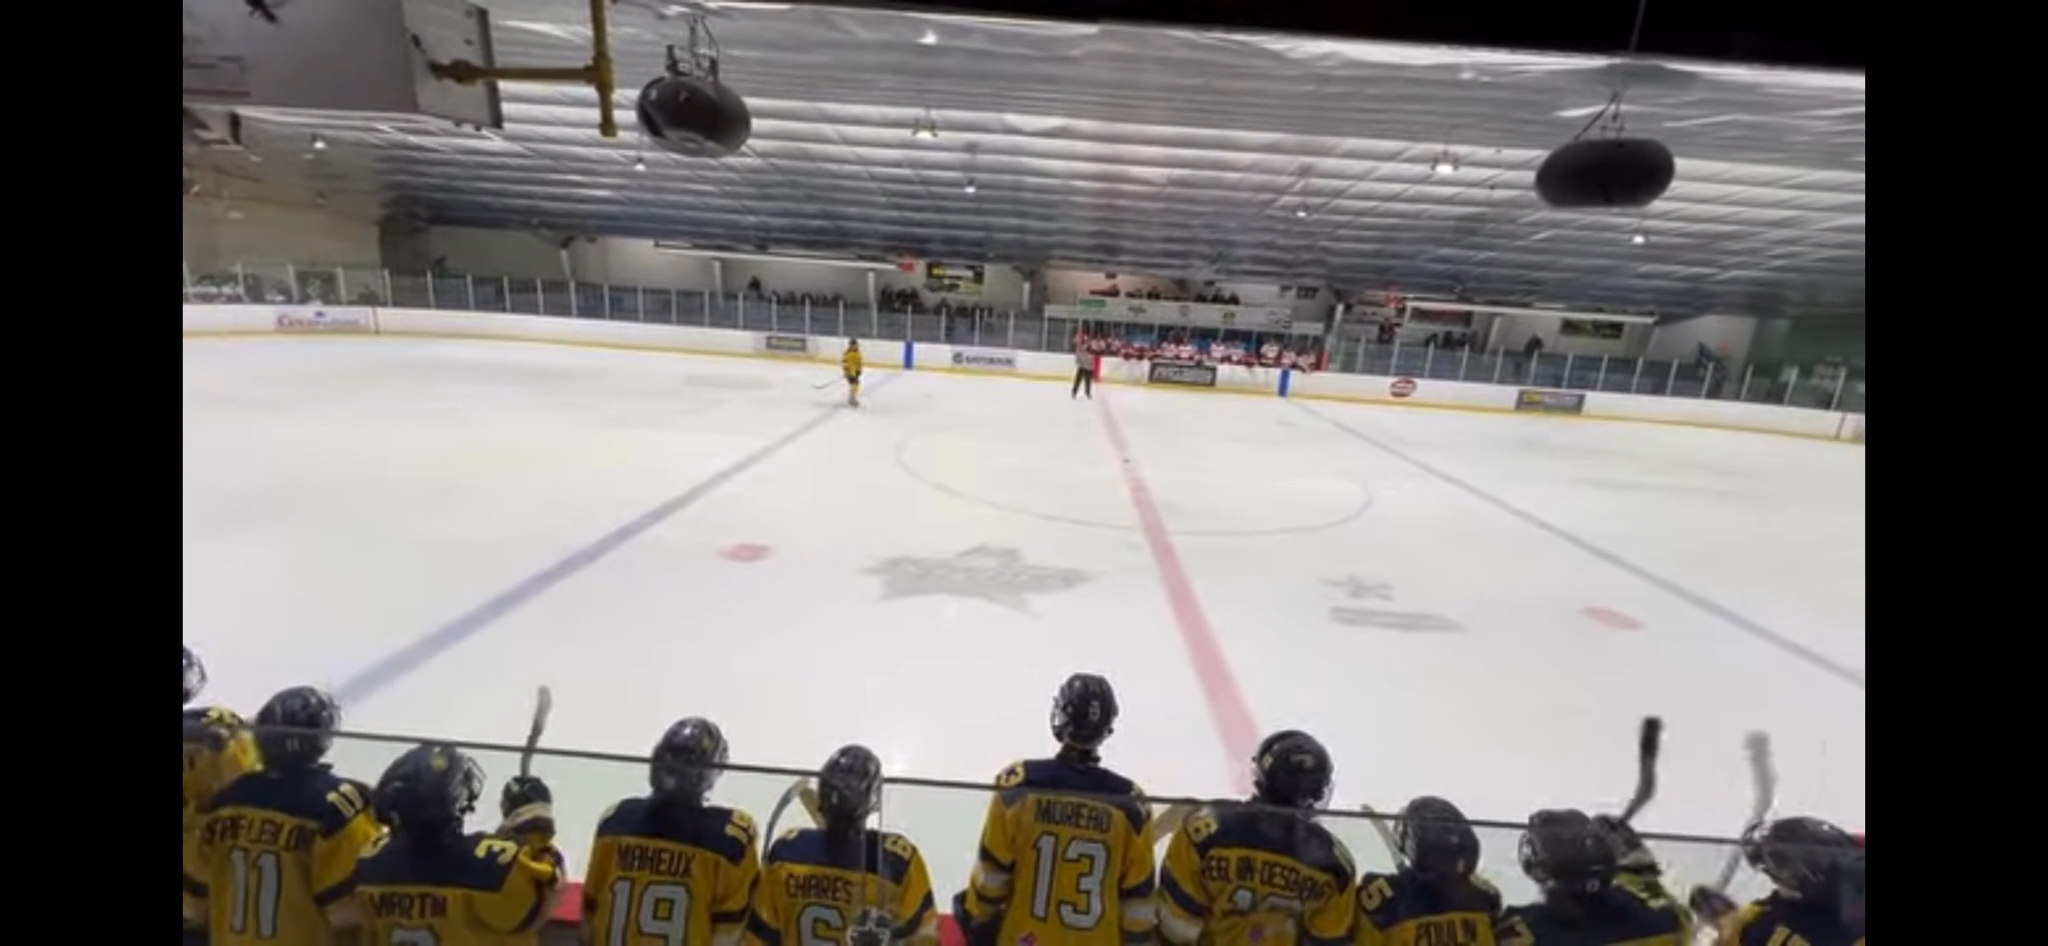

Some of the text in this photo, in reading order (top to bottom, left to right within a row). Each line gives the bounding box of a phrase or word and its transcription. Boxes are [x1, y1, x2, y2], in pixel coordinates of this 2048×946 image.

[473, 838, 518, 864] 3
[617, 842, 696, 878] MAHEUX
[1029, 830, 1111, 930] 13
[228, 845, 283, 939] 11
[607, 874, 693, 946] 19
